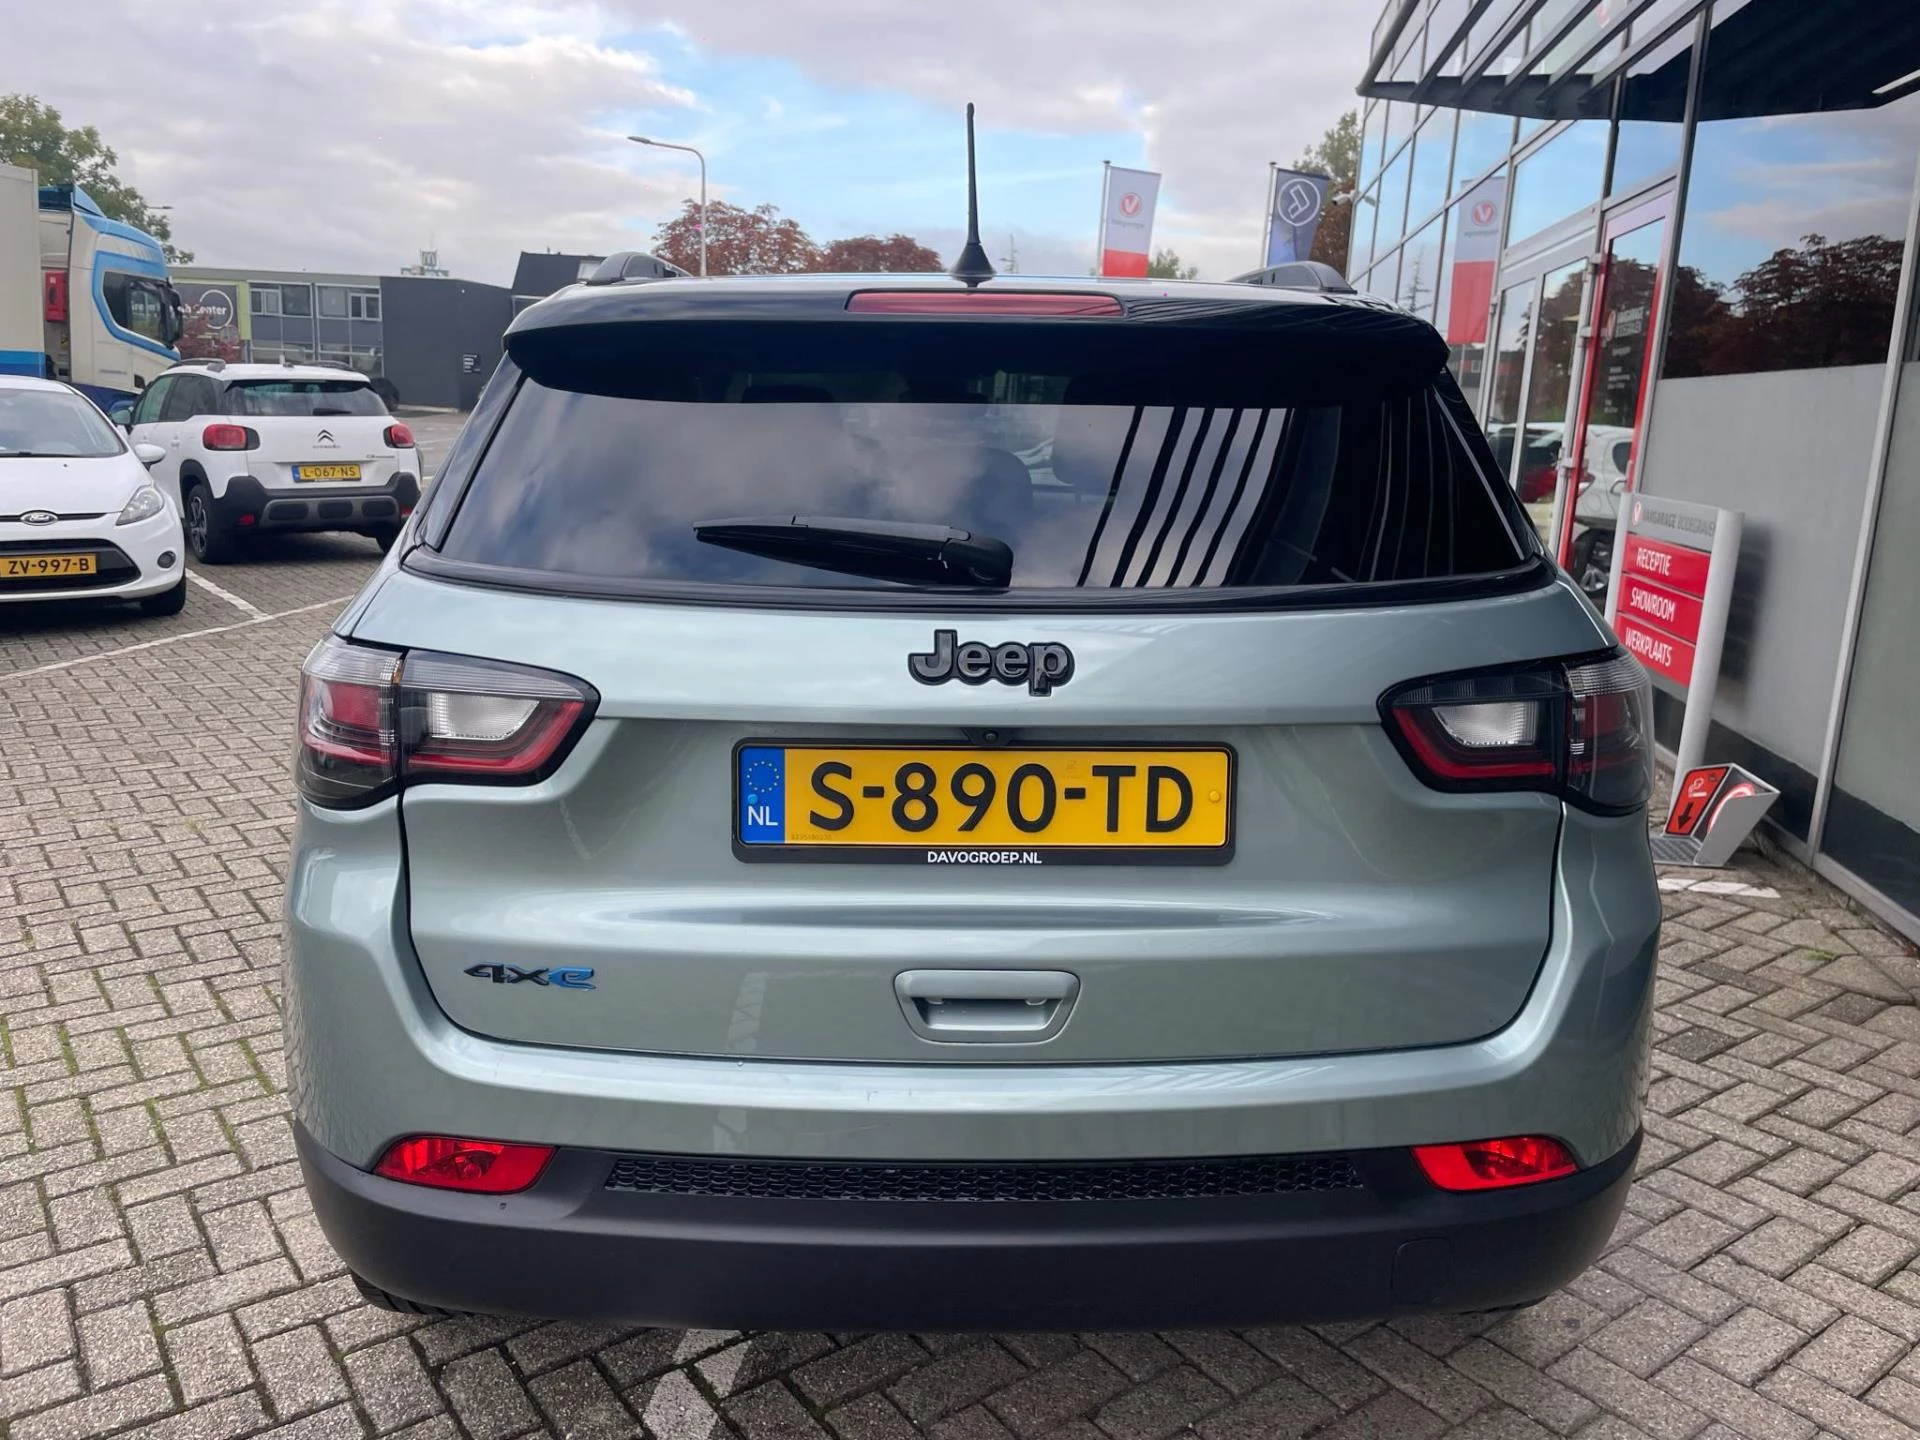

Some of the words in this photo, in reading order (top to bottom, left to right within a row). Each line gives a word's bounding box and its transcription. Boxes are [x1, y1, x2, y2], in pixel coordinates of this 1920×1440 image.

[303, 466, 357, 478] L-067-NS
[8, 557, 90, 575] ZV-997-B
[1636, 547, 1672, 577] RECEPTIE
[1630, 587, 1676, 622] SHOWROOM
[1625, 626, 1673, 667] WERKPLAATS
[908, 629, 1075, 697] Jeep
[747, 806, 778, 827] NL
[809, 761, 1193, 834] S-890-TD
[927, 850, 1043, 864] DAVOGROEP.NL
